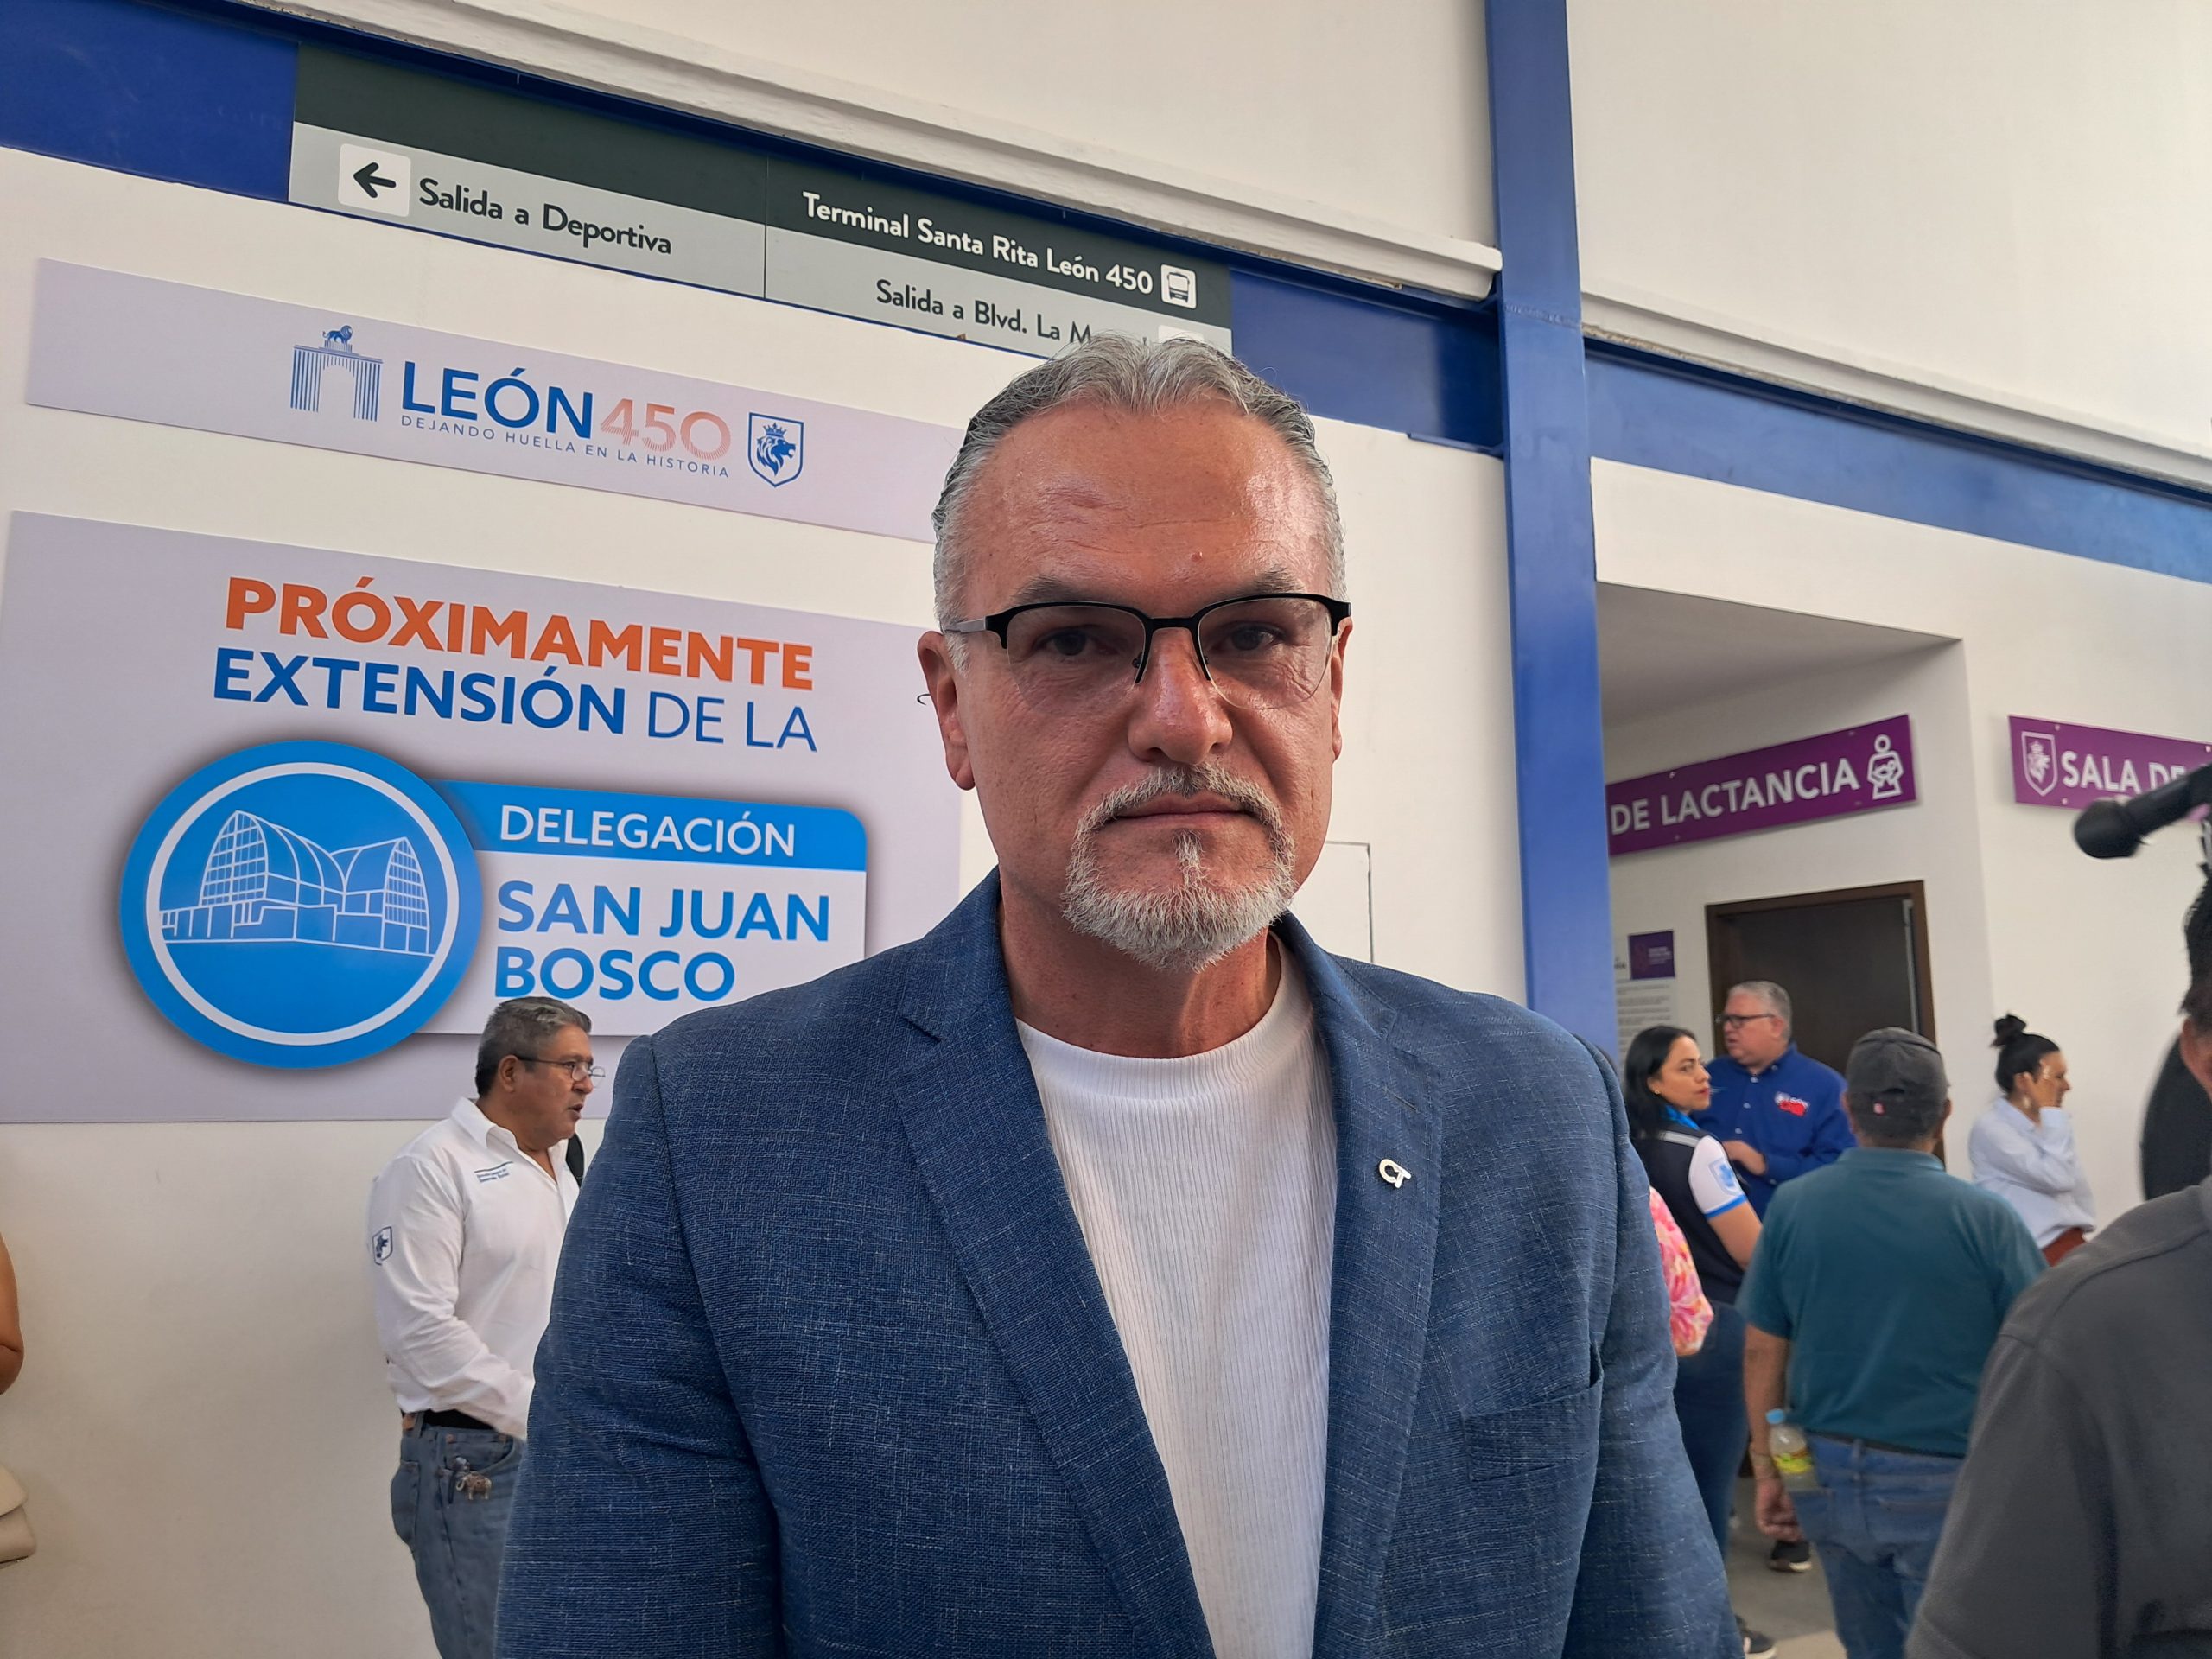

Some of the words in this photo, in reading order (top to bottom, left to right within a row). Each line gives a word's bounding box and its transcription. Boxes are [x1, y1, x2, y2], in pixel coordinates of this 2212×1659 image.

[419, 178, 502, 219] Salida
[514, 207, 529, 226] a
[543, 204, 671, 255] Deportiva
[802, 191, 910, 238] Terminal
[917, 219, 984, 256] Santa
[993, 235, 1038, 269] Rita
[1046, 247, 1100, 283] León
[1105, 265, 1154, 295] 450
[876, 279, 944, 316] Salida
[952, 302, 965, 321] a
[975, 301, 1027, 334] Blvd.
[1036, 314, 1060, 341] La
[401, 415, 495, 440] DEJANDO
[505, 431, 575, 454] HUELLA
[585, 444, 607, 459] EN
[617, 449, 638, 463] LA
[646, 454, 729, 478] HISTORIA
[225, 576, 813, 690] PRÓXIMAMENTE
[213, 648, 626, 734] EXTENSIÓN
[647, 691, 725, 744] DE
[746, 701, 817, 753] LA
[1610, 798, 1651, 836] DE
[1660, 756, 1861, 826] LACTANCIA
[2061, 750, 2142, 794] SALA
[500, 804, 795, 857] DELEGACIÓN
[497, 880, 641, 937] SAN
[659, 888, 830, 942] JUAN
[494, 946, 735, 1001] BOSCO
